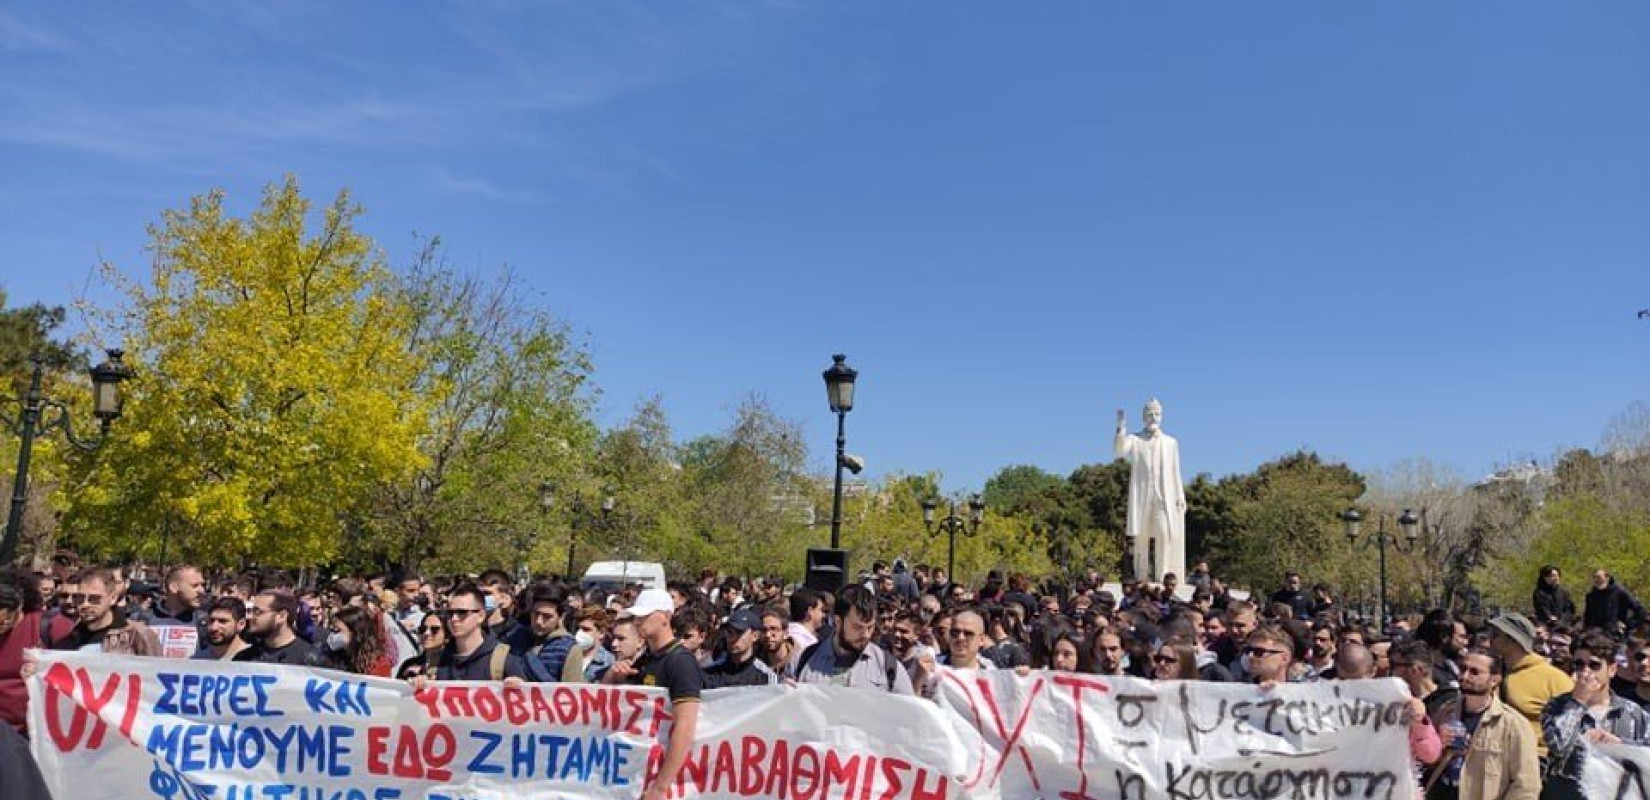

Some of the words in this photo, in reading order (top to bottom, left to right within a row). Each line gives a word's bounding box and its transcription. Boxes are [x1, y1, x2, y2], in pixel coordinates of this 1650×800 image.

[45, 662, 141, 752] ΟΧΙ
[153, 673, 284, 716] ΣΕΡΡΕΣ
[304, 678, 371, 716] ΚΑΙ
[147, 723, 354, 776] ΜΕΝΟΥΜΕ
[367, 723, 456, 781] ΕΔΩ
[467, 730, 632, 785] ΖΗΤΑΜΕ
[641, 736, 947, 800] ΑΝΑΒΑΘΜΙΣΗ
